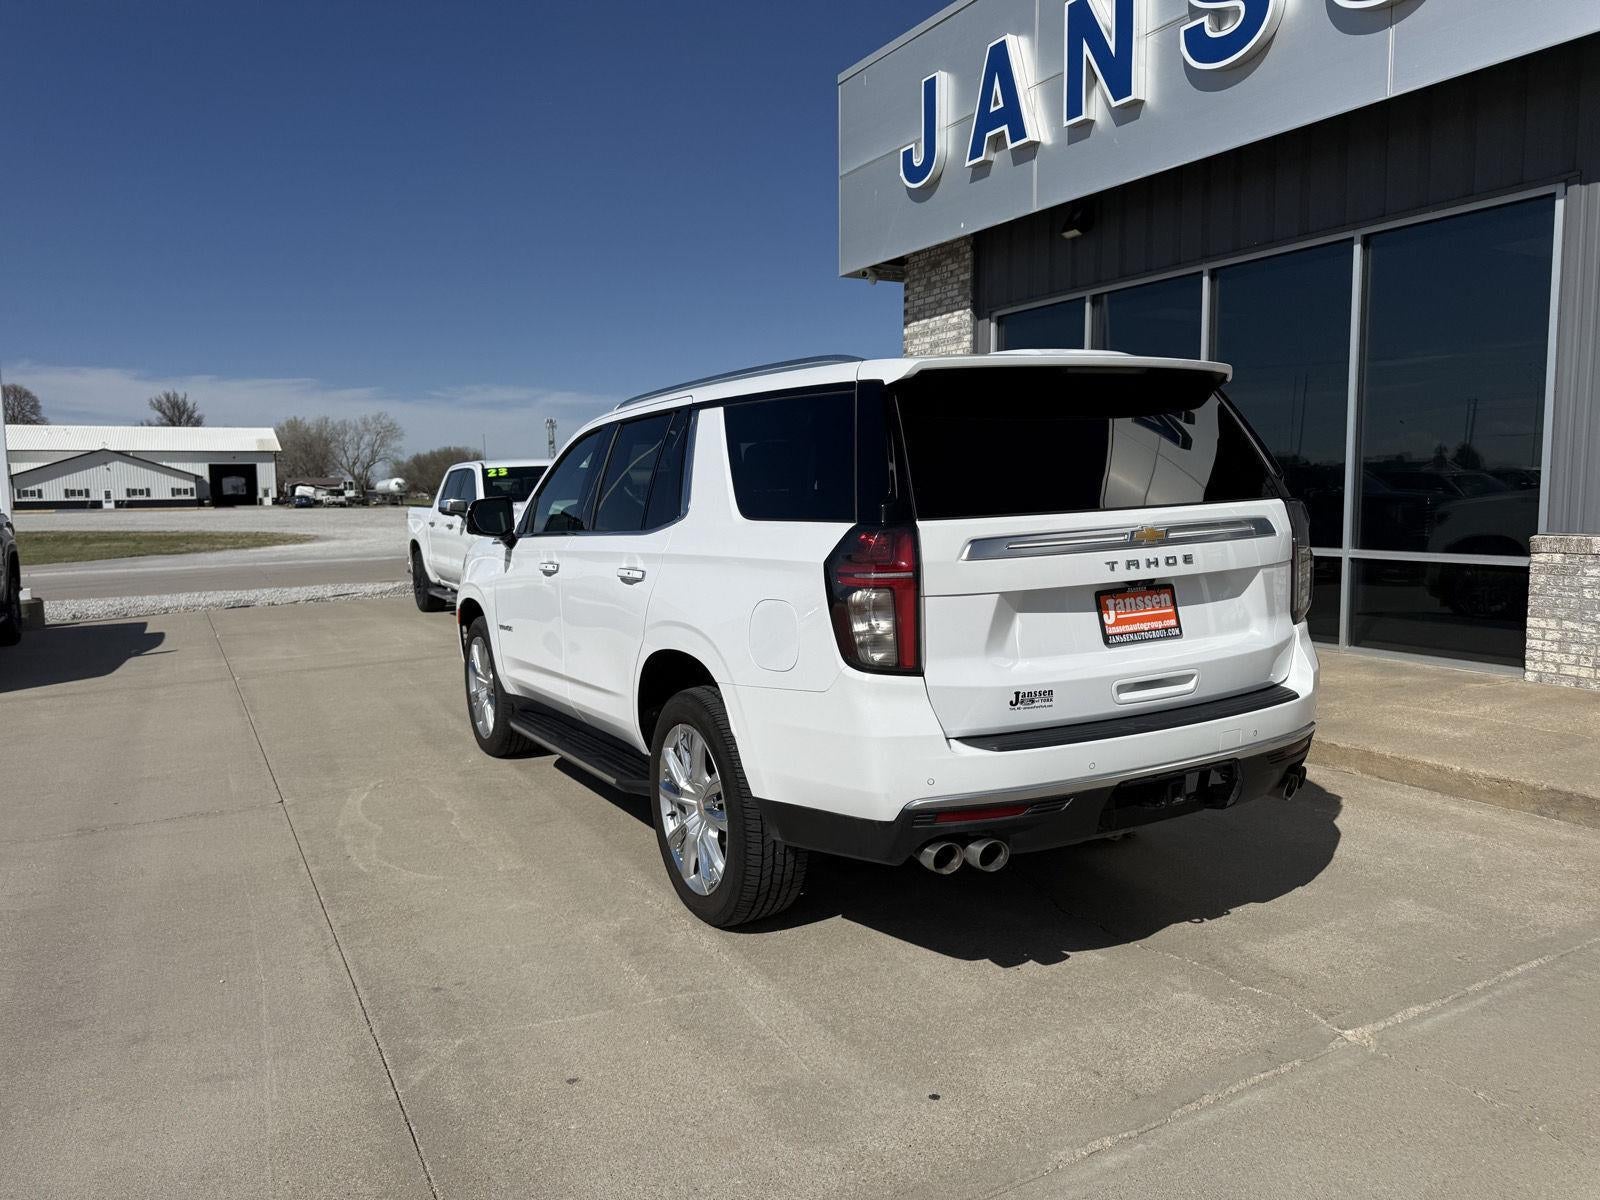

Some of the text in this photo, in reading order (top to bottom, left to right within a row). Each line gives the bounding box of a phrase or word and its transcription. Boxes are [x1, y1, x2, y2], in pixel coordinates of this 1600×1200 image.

[487, 467, 508, 477] 23
[1105, 554, 1194, 571] TAHOE
[1103, 593, 1171, 624] Janssen
[1108, 629, 1181, 643] JANSSENAUTOGROUP.COM
[1009, 690, 1053, 706] Janssen
